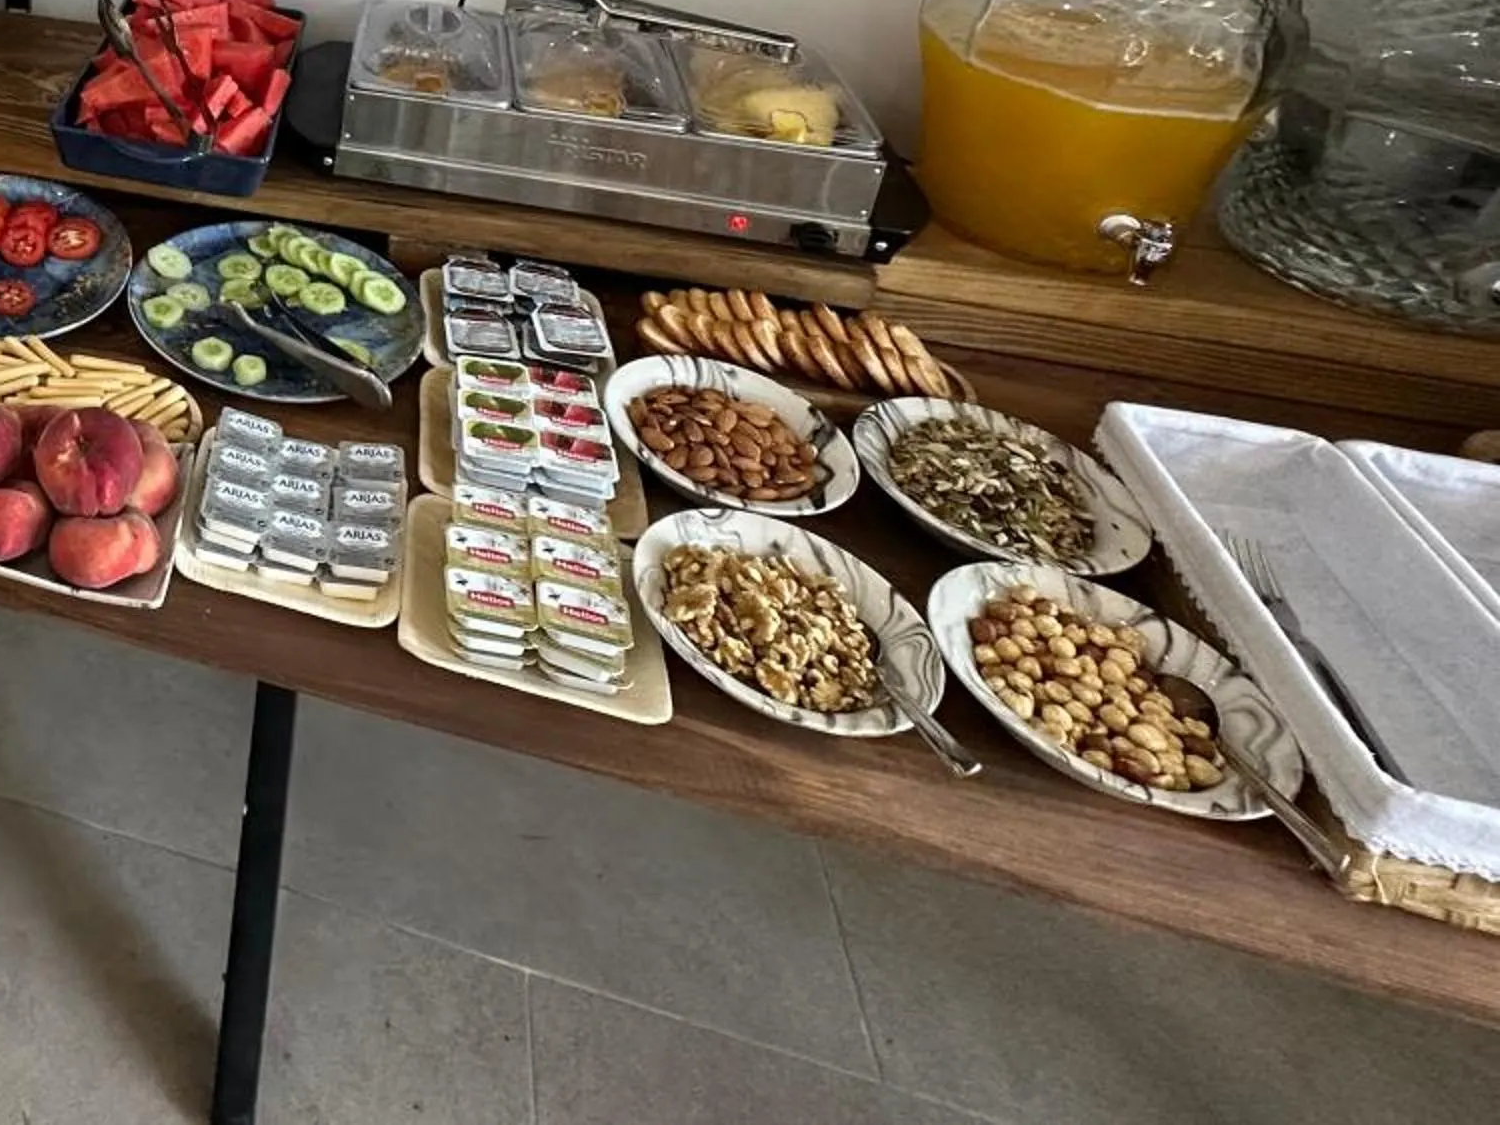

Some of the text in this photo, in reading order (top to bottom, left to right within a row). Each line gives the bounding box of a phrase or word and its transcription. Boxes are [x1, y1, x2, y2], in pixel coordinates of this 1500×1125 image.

[235, 415, 271, 434] ARIAS
[285, 442, 321, 458] ARIAS
[354, 447, 391, 460] ARIAS
[226, 450, 262, 467] ARIAS
[278, 477, 315, 493] ARIAS
[221, 485, 259, 503] ARIAS
[349, 492, 387, 505] ARIAS
[278, 514, 317, 533] ARIAS
[343, 529, 382, 543] ARIAS
